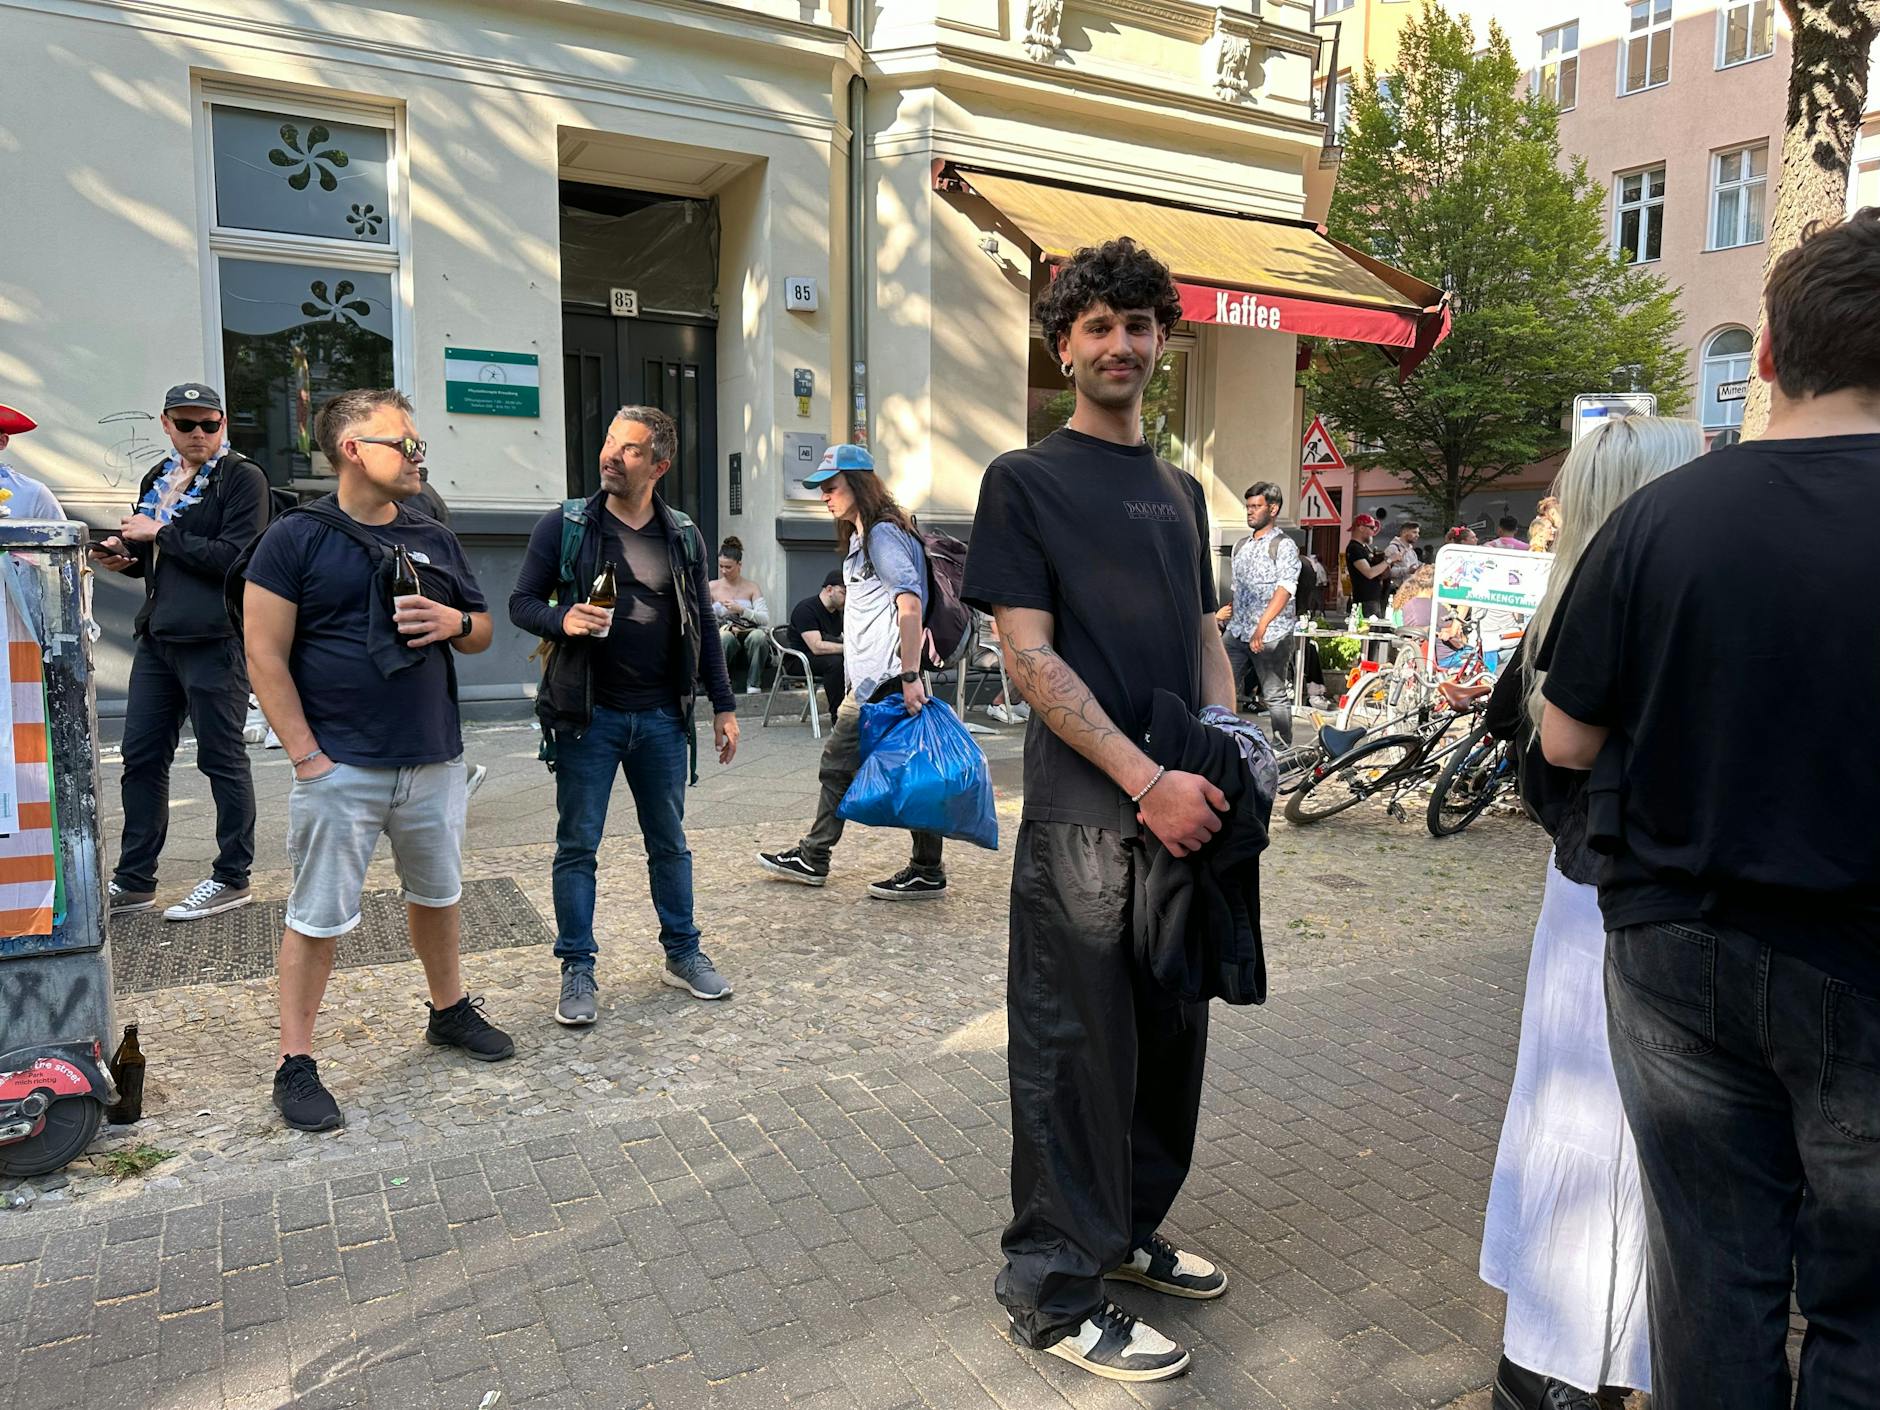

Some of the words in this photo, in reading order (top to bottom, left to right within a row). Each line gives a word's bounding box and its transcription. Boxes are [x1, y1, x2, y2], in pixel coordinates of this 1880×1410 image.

[615, 291, 633, 308] 85
[795, 285, 810, 301] 85
[1215, 291, 1281, 330] Kaffee
[54, 1063, 81, 1085] street
